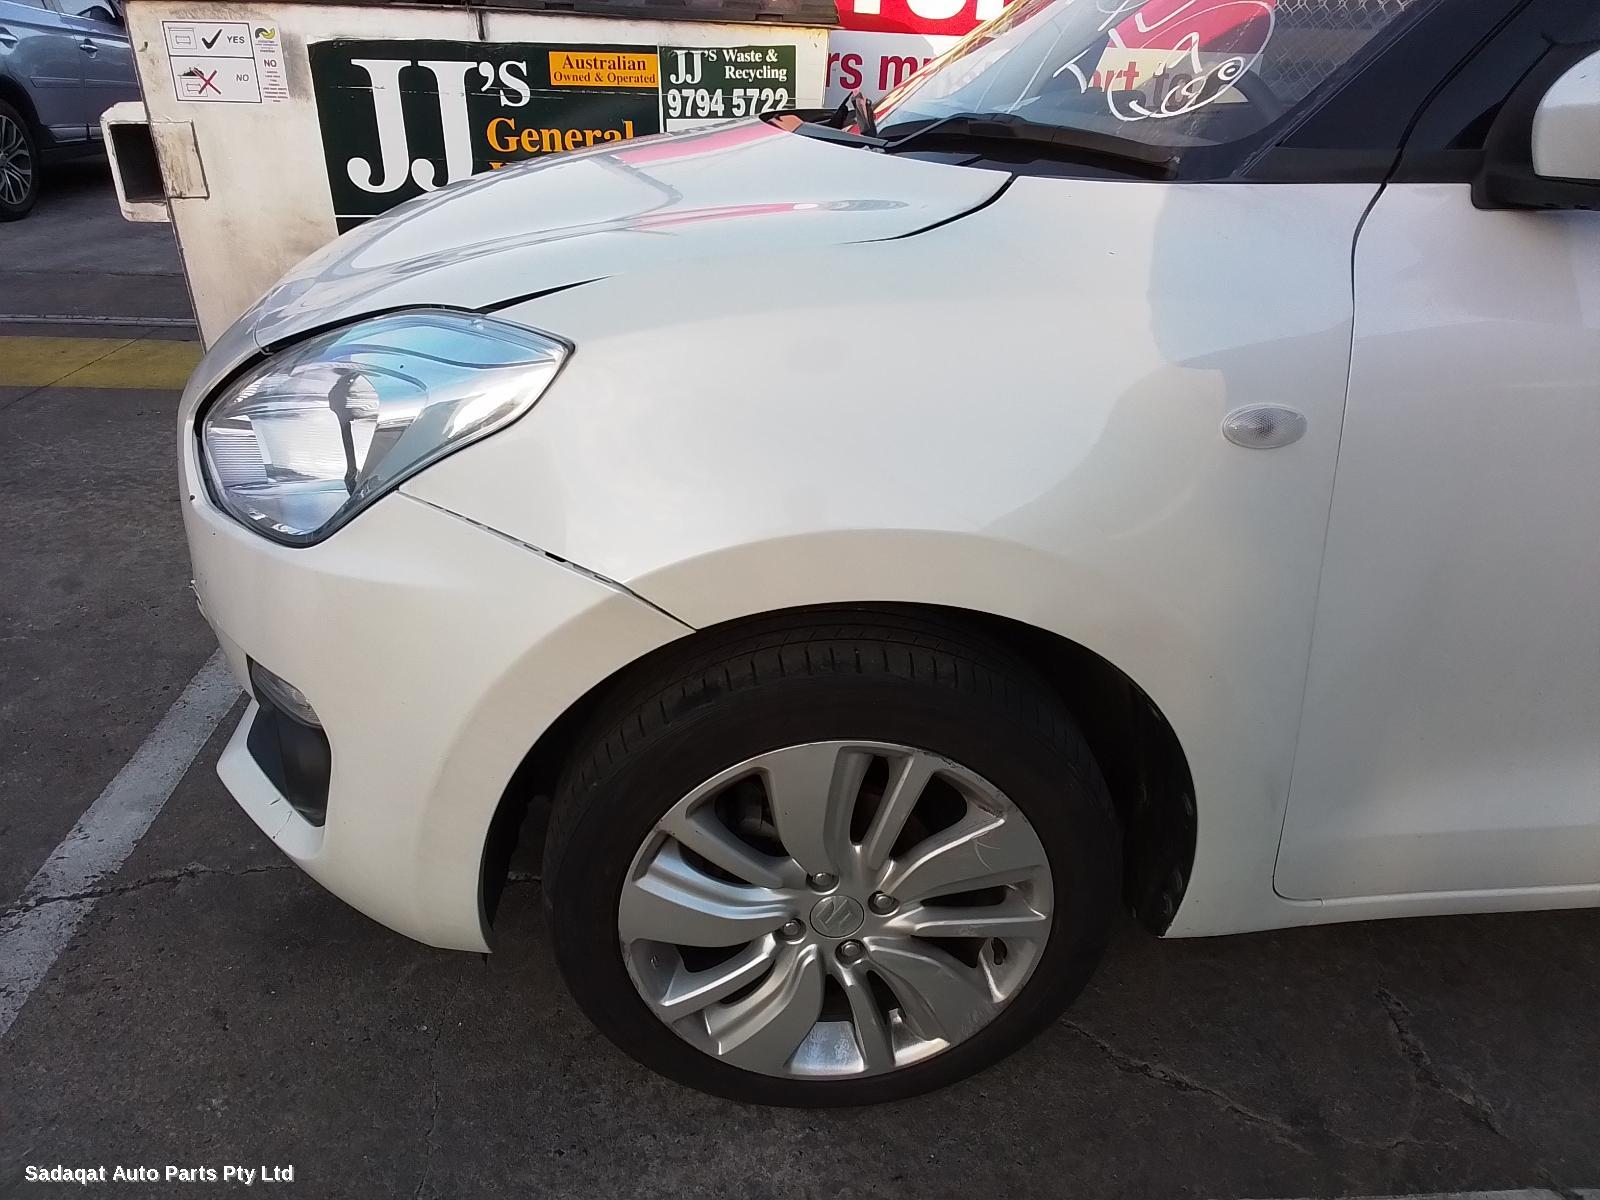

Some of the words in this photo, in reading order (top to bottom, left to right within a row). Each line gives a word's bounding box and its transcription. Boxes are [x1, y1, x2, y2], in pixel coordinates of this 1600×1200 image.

[226, 36, 245, 44] YES
[562, 54, 647, 71] Australian
[722, 49, 763, 63] Waste
[766, 48, 778, 62] &
[263, 59, 277, 68] NO
[236, 74, 250, 82] NO
[553, 71, 591, 82] Owned
[594, 72, 604, 82] &
[607, 72, 656, 86] Operated
[724, 65, 788, 82] Recycling
[667, 88, 725, 118] 9794
[731, 87, 789, 118] 5722
